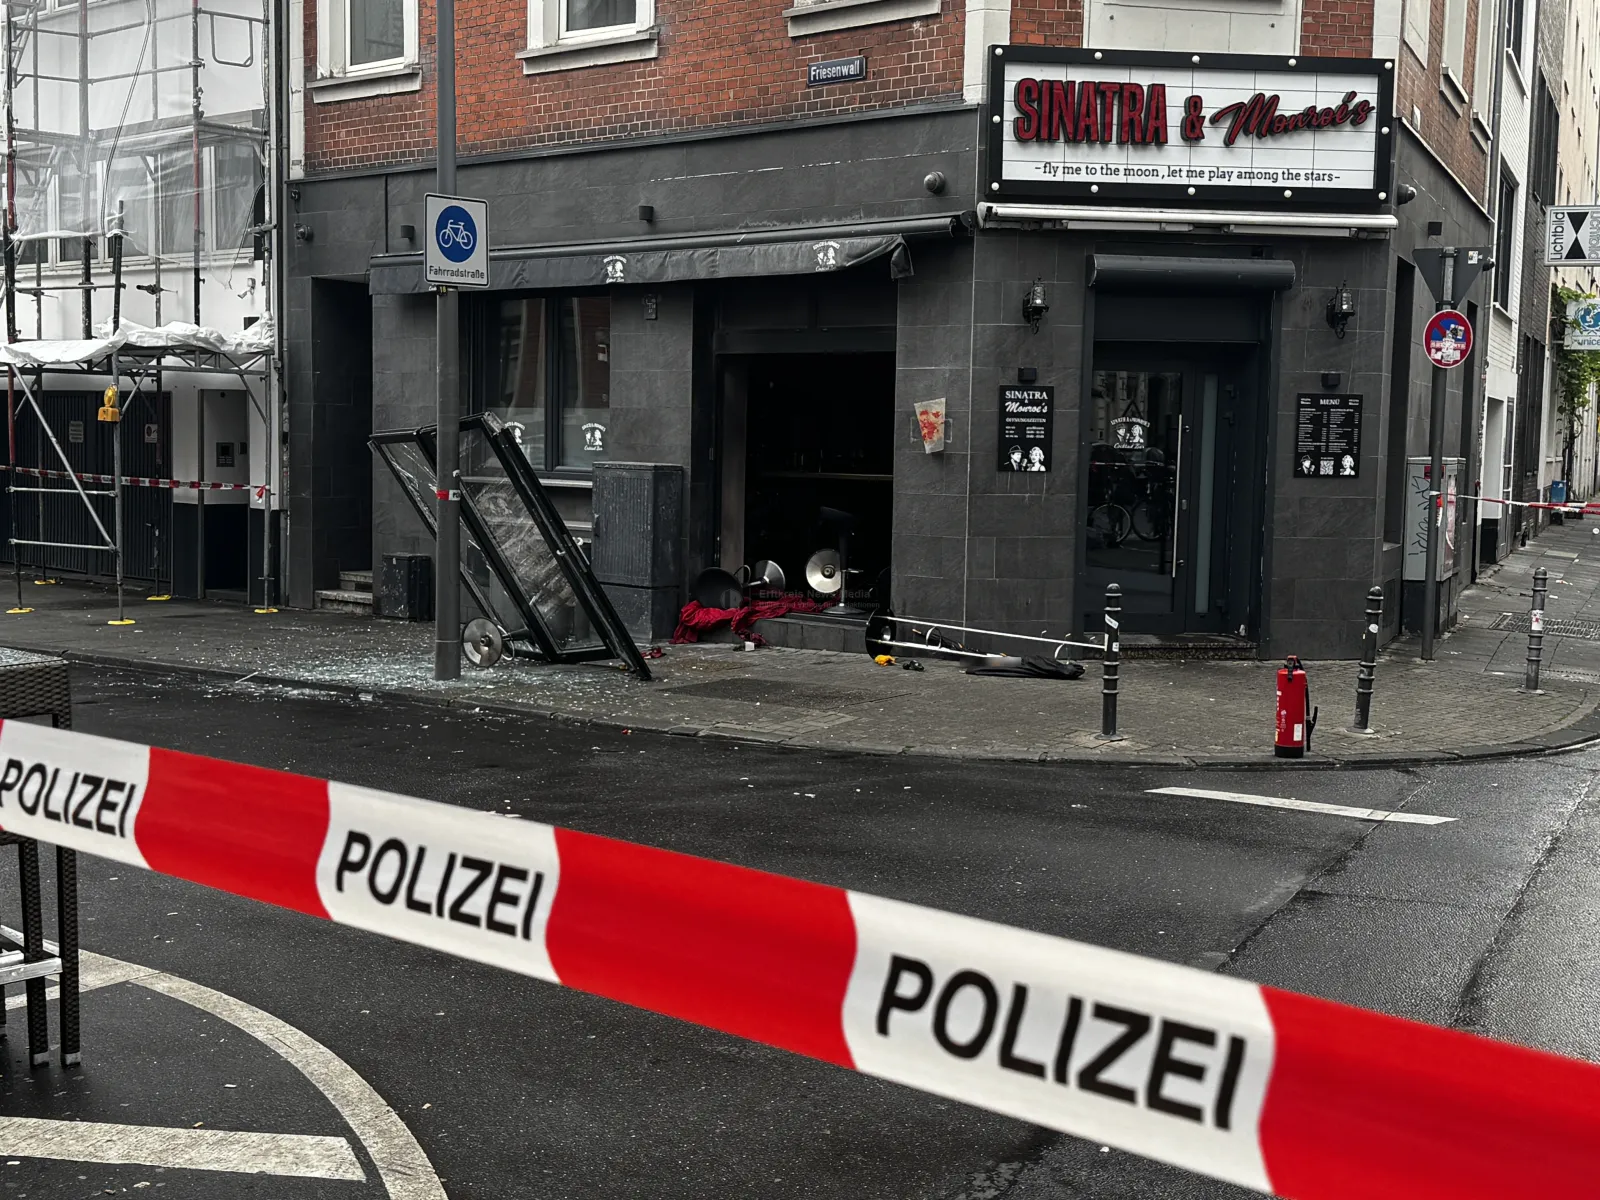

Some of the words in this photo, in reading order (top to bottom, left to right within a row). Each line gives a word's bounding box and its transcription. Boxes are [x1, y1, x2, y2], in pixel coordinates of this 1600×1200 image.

[810, 60, 860, 81] Friesenwall
[1014, 77, 1169, 145] SINATRA
[1180, 94, 1206, 141] &
[1062, 165, 1082, 175] me
[1085, 165, 1098, 176] to
[1100, 163, 1120, 176] the
[1186, 168, 1205, 179] me
[1208, 166, 1234, 181] play
[1236, 170, 1279, 183] among
[1281, 168, 1301, 181] the
[1550, 211, 1565, 260] Lichtbild
[428, 265, 485, 279] Fahrradstraße
[1004, 401, 1048, 413] Monroe's
[1005, 390, 1048, 400] SINATRA
[0, 758, 136, 839] POLIZEI
[336, 830, 544, 942] POLIZEI
[876, 952, 1247, 1132] POLIZEI
